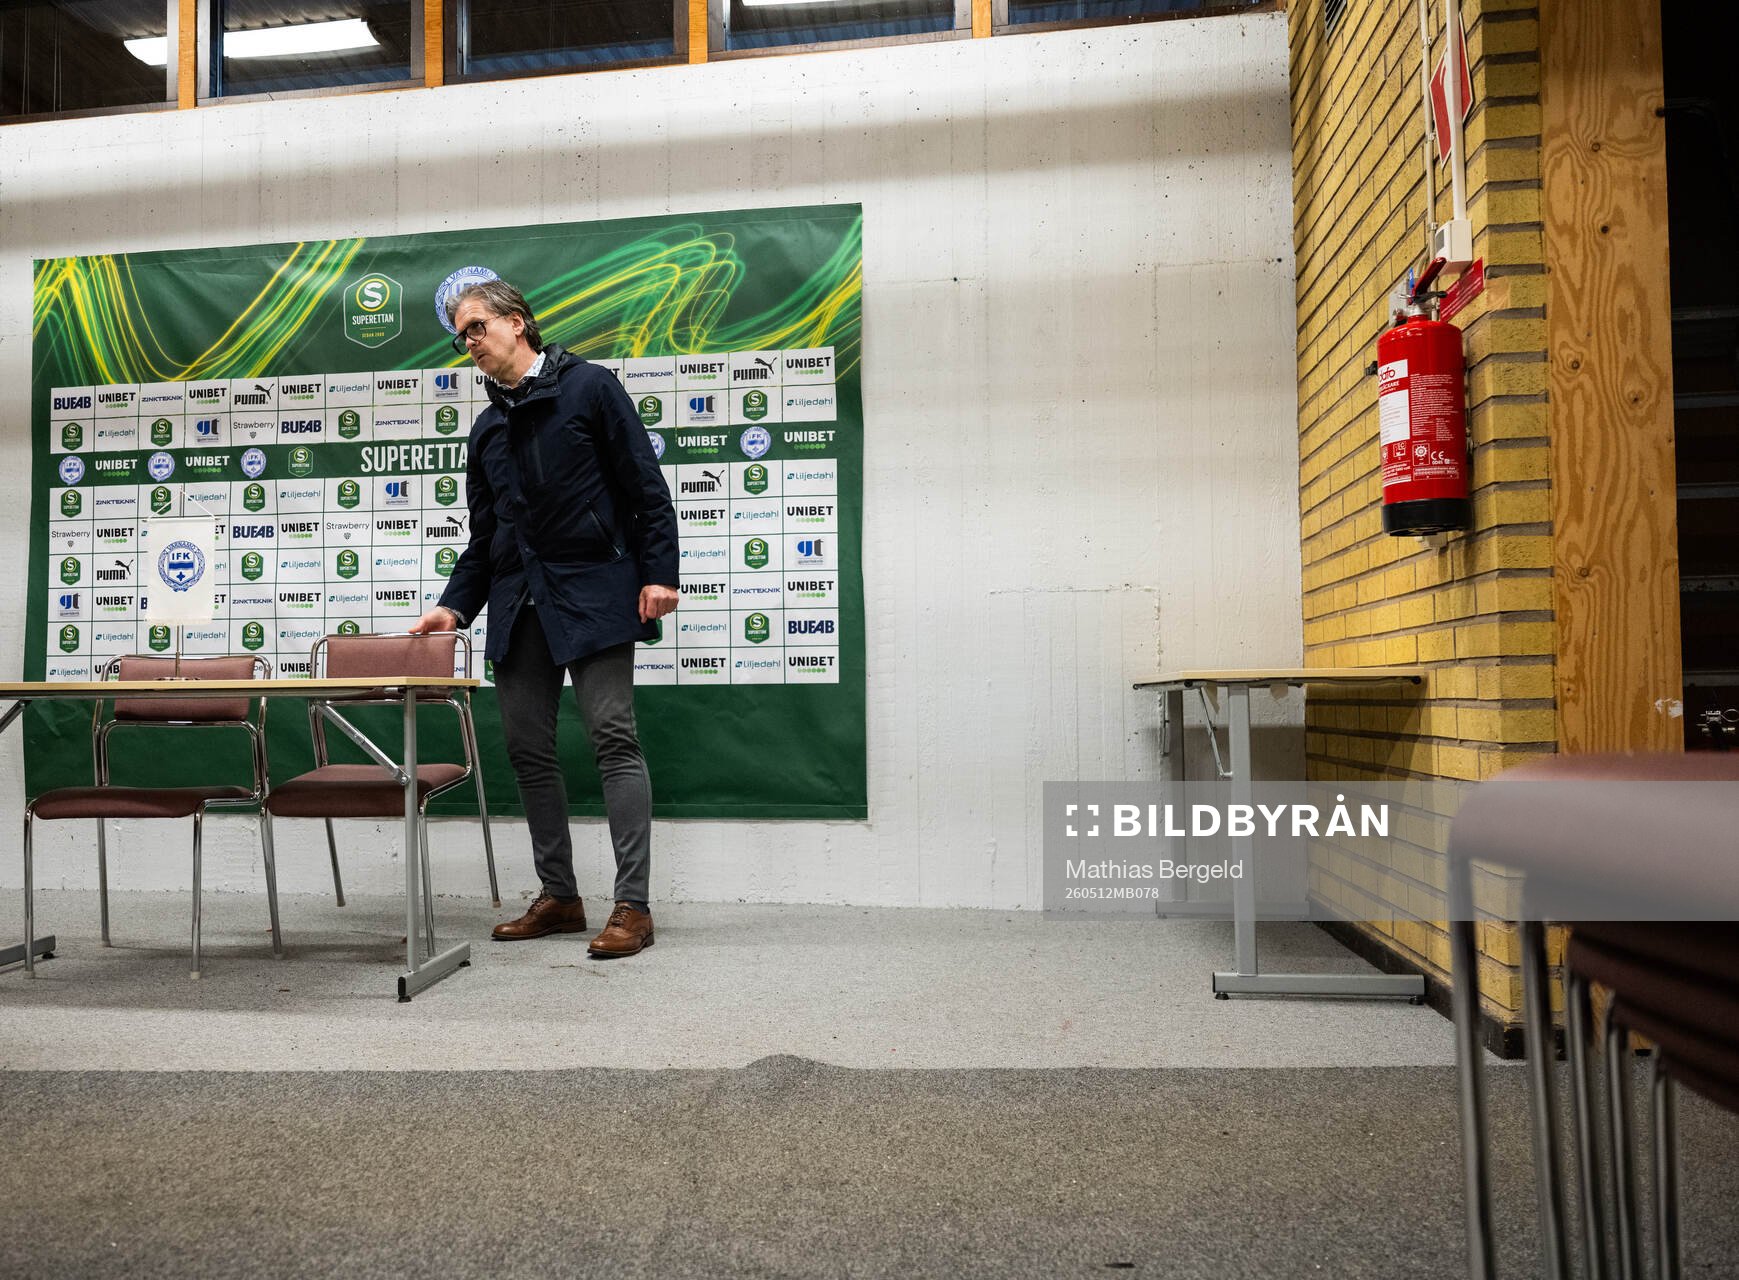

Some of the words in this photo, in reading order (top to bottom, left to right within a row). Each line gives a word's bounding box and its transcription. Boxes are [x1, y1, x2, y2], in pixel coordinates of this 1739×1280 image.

[352, 314, 394, 325] SUPERETTAN
[786, 357, 831, 368] UNIBET
[680, 363, 724, 373] UNIBET
[626, 370, 673, 378] ZINKTEKNIK
[733, 369, 767, 380] PUMA
[282, 384, 321, 394] UNIBET
[336, 384, 370, 393] Liljedahl
[378, 379, 418, 389] UNIBET
[99, 393, 136, 403] UNIBET
[189, 388, 227, 399] UNIBET
[54, 397, 91, 410] BUFAB
[234, 395, 266, 404] PUMA
[795, 398, 832, 407] Liljedahl
[233, 421, 275, 430] Strawberry
[281, 420, 321, 433] BUFAB
[105, 429, 135, 438] Liljedahl
[784, 431, 835, 442] UNIBET
[678, 435, 727, 446] UNIBET
[186, 456, 229, 466] UNIBET
[361, 443, 468, 472] SUPERETTA
[96, 459, 137, 469] UNIBET
[795, 472, 833, 481] Liljedahl
[681, 481, 715, 493] PUMA
[194, 493, 226, 502] Liljedahl
[287, 490, 320, 499] Liljedahl
[681, 510, 725, 520] UNIBET
[742, 511, 778, 520] Liljedahl
[787, 506, 833, 516] UNIBET
[281, 522, 319, 532] UNIBET
[327, 522, 369, 530] Strawberry
[377, 520, 418, 530] UNIBET
[97, 528, 134, 537] UNIBET
[233, 526, 274, 538] BUFAB
[427, 526, 458, 537] PUMA
[172, 552, 190, 560] IFK
[689, 550, 726, 559] Liljedahl
[288, 560, 320, 569] Liljedahl
[97, 569, 125, 580] PUMA
[681, 584, 725, 594] UNIBET
[788, 581, 834, 590] UNIBET
[96, 596, 133, 605] UNIBET
[280, 593, 321, 602] UNIBET
[336, 594, 368, 602] Liljedahl
[376, 591, 416, 600] UNIBET
[689, 624, 726, 633] Liljedahl
[789, 621, 834, 633] BUFAB
[102, 633, 133, 642] Liljedahl
[193, 632, 226, 640] Liljedahl
[286, 630, 320, 639] Liljedahl
[682, 658, 726, 668] UNIBET
[744, 660, 780, 669] Liljedahl
[789, 656, 834, 666] UNIBET
[57, 668, 88, 677] Liljedahl
